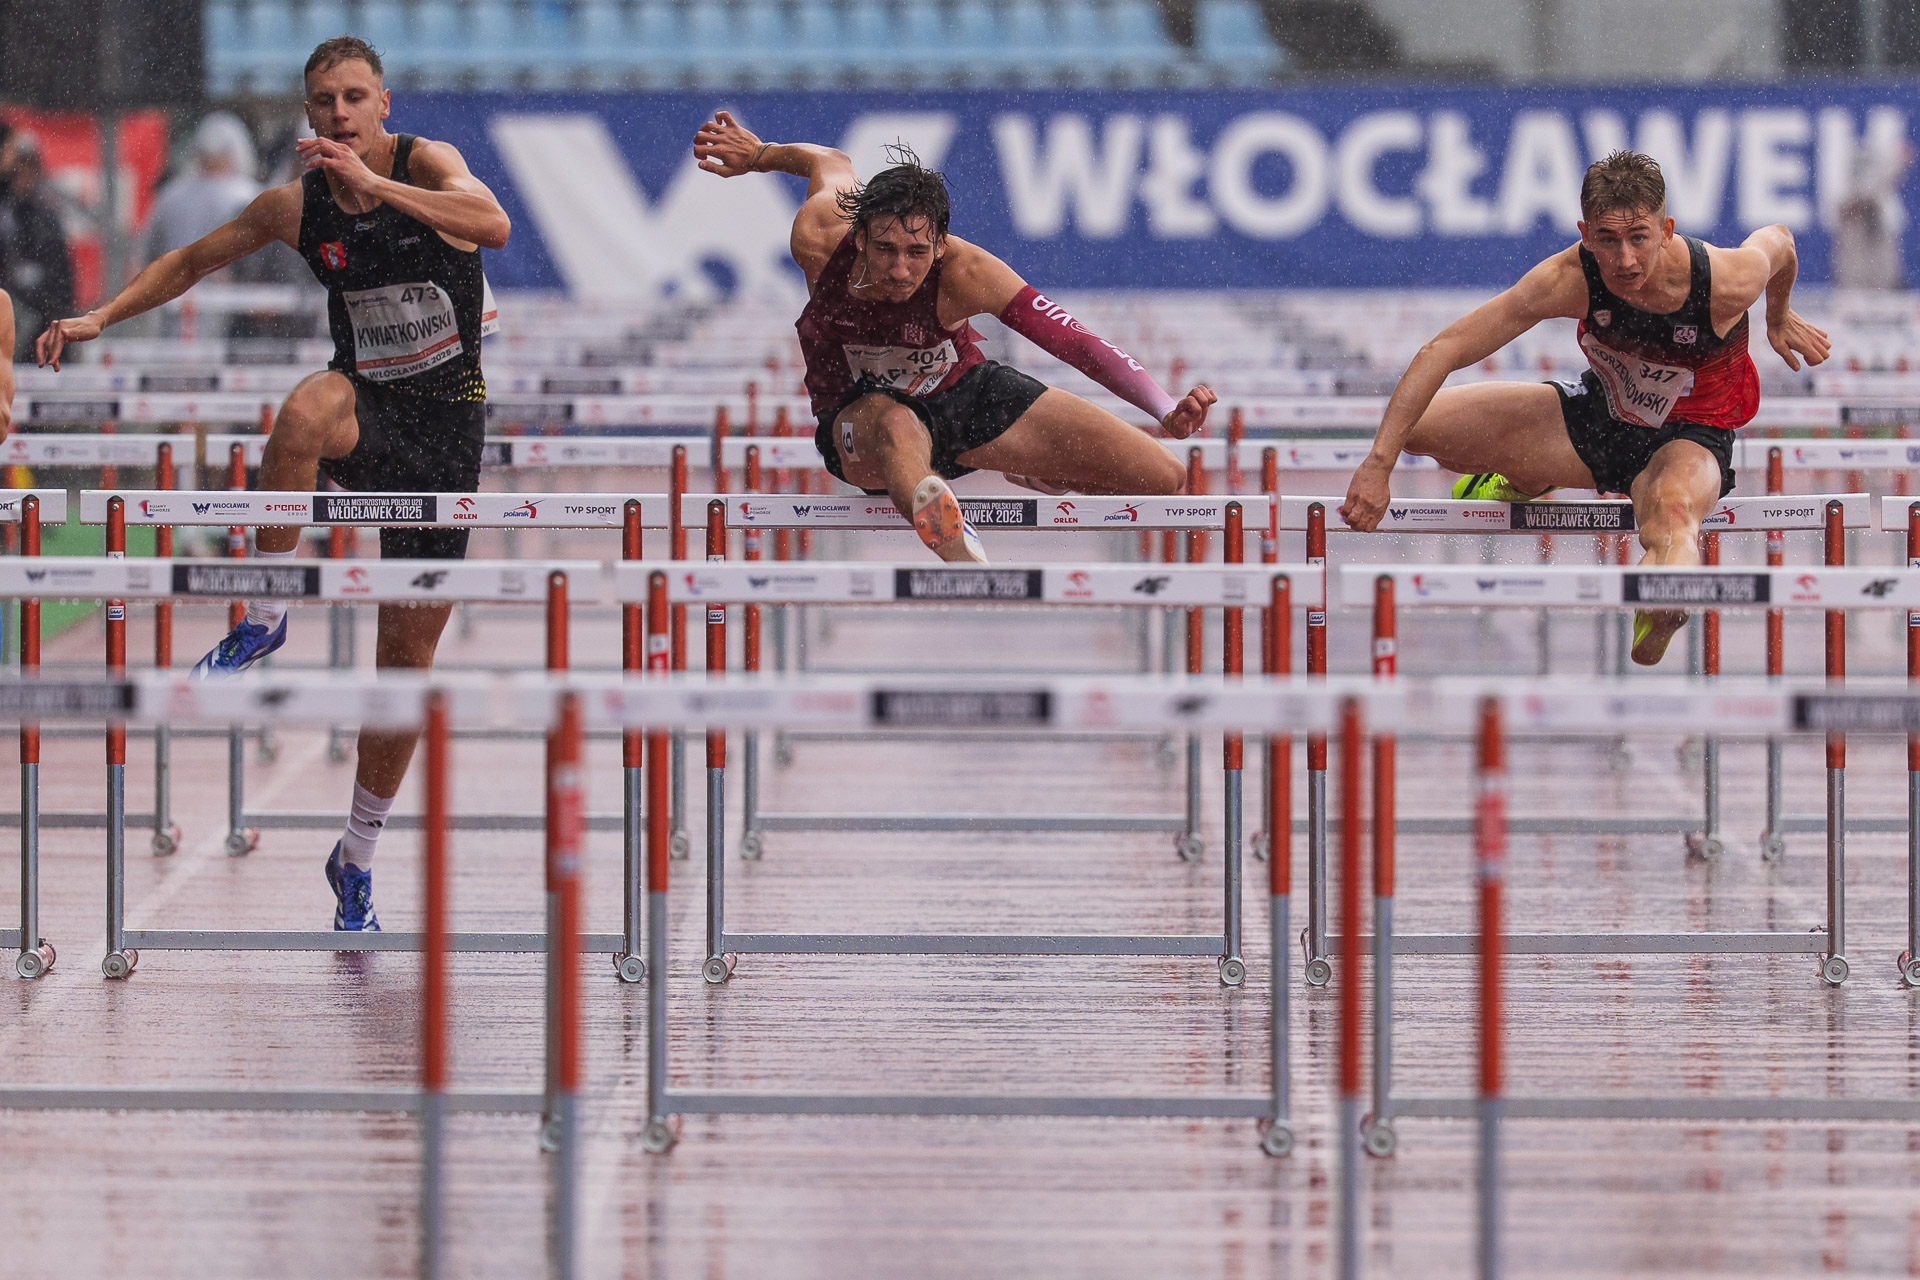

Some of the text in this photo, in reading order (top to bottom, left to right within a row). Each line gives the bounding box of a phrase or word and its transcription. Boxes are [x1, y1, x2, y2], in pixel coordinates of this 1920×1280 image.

[400, 287, 440, 305] 473
[357, 311, 452, 349] KWIATKOWSKI
[906, 347, 948, 364] 404
[369, 349, 452, 379] WŁOCŁAWEK 2025
[1639, 363, 1678, 383] 347
[1590, 346, 1669, 417] KORZENIOWSKI
[0, 502, 14, 511] ORT
[337, 498, 351, 507] PZLA
[351, 498, 390, 507] MISTRZOSTWA
[390, 498, 411, 507] POLSKI
[411, 498, 423, 506] U20
[958, 502, 991, 510] STRZOSTWA
[327, 506, 423, 520] WŁOCŁAWEK 2025
[503, 510, 530, 519] polanik
[565, 506, 617, 514] TVP SPORT
[1165, 508, 1217, 516] TVP SPORT
[1549, 506, 1588, 514] MISTRZOSTWA
[1589, 506, 1609, 514] POLSKI
[1763, 508, 1815, 518] TVP SPORT
[963, 510, 1023, 523] AWEK 2025
[1104, 514, 1130, 522] polanik
[1525, 513, 1620, 528] WŁOCŁAWEK 2025
[1702, 516, 1728, 525] polanik
